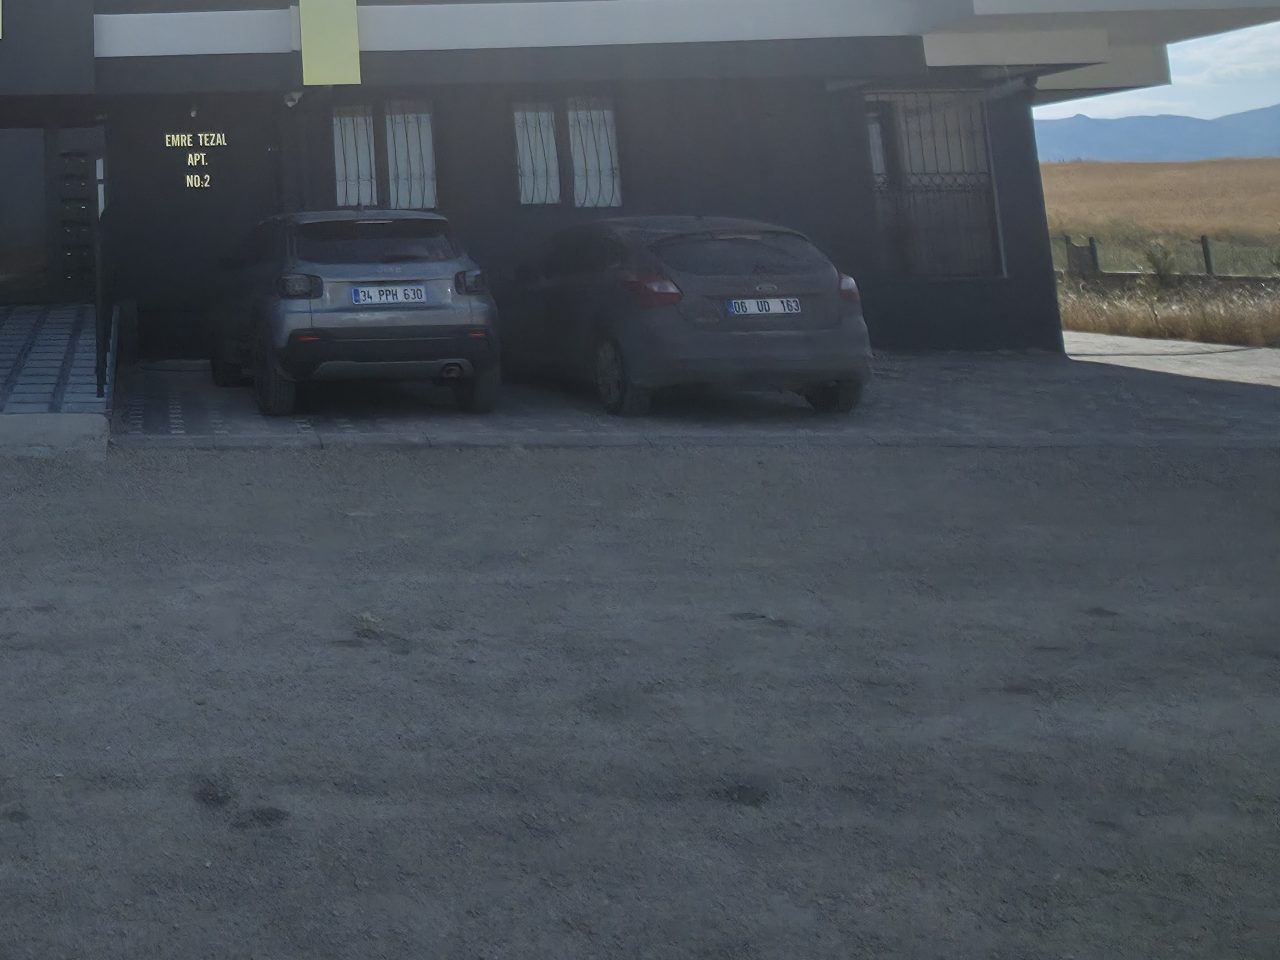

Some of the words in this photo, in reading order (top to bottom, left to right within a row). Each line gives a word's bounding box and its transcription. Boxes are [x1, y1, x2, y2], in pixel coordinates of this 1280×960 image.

[165, 134, 193, 147] EMRE
[197, 133, 227, 146] TEZAL
[187, 153, 208, 166] APT.
[186, 174, 210, 188] NO:2
[360, 290, 373, 303] 34
[378, 288, 399, 301] PPH
[403, 288, 423, 300] 630
[781, 299, 800, 312] 163
